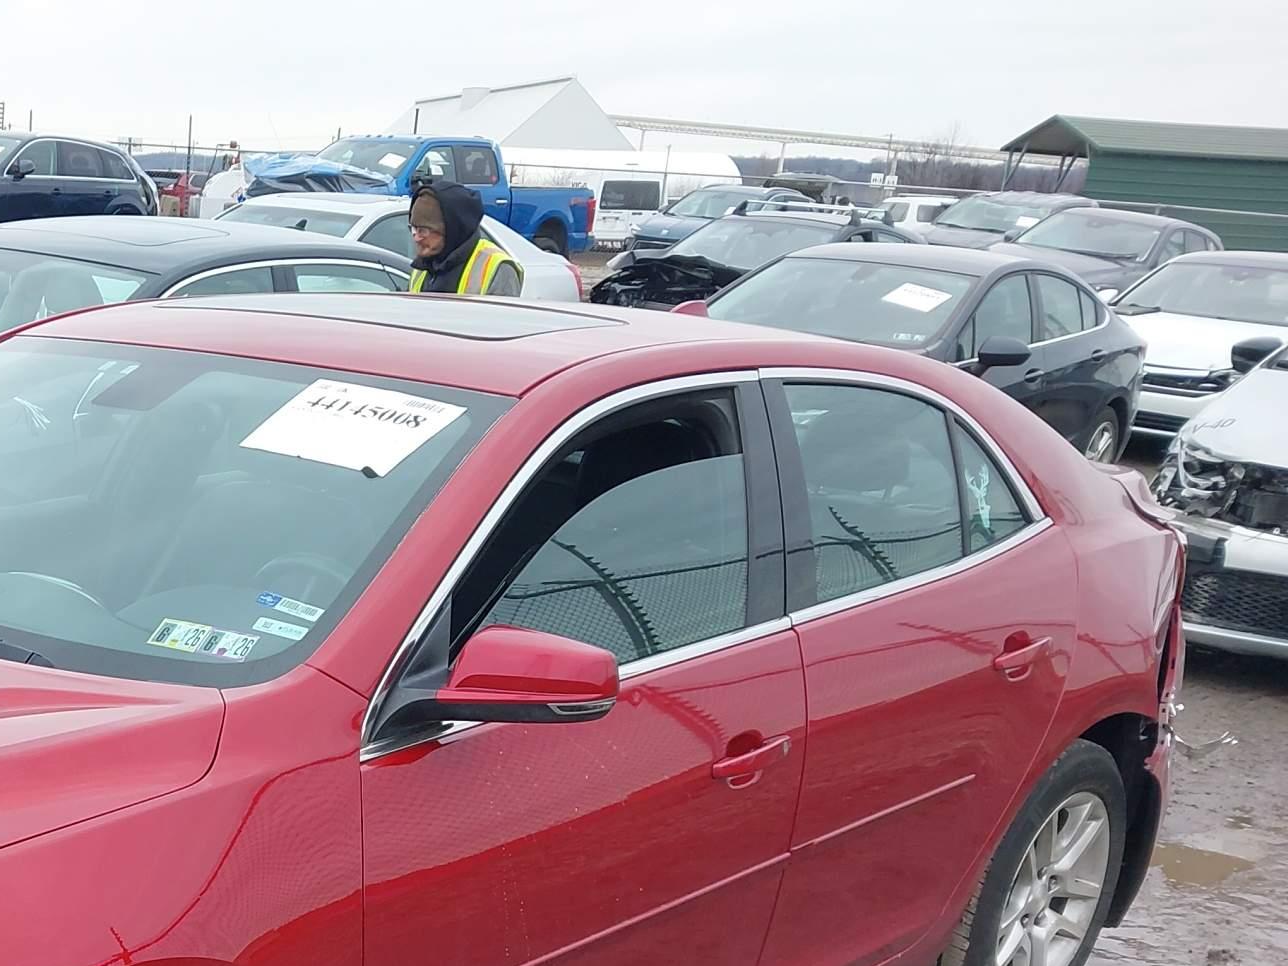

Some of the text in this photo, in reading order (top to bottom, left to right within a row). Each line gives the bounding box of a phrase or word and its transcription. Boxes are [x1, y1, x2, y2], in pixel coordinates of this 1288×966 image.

[307, 396, 427, 428] 44145008
[184, 629, 205, 646] 26
[233, 638, 254, 656] 26
